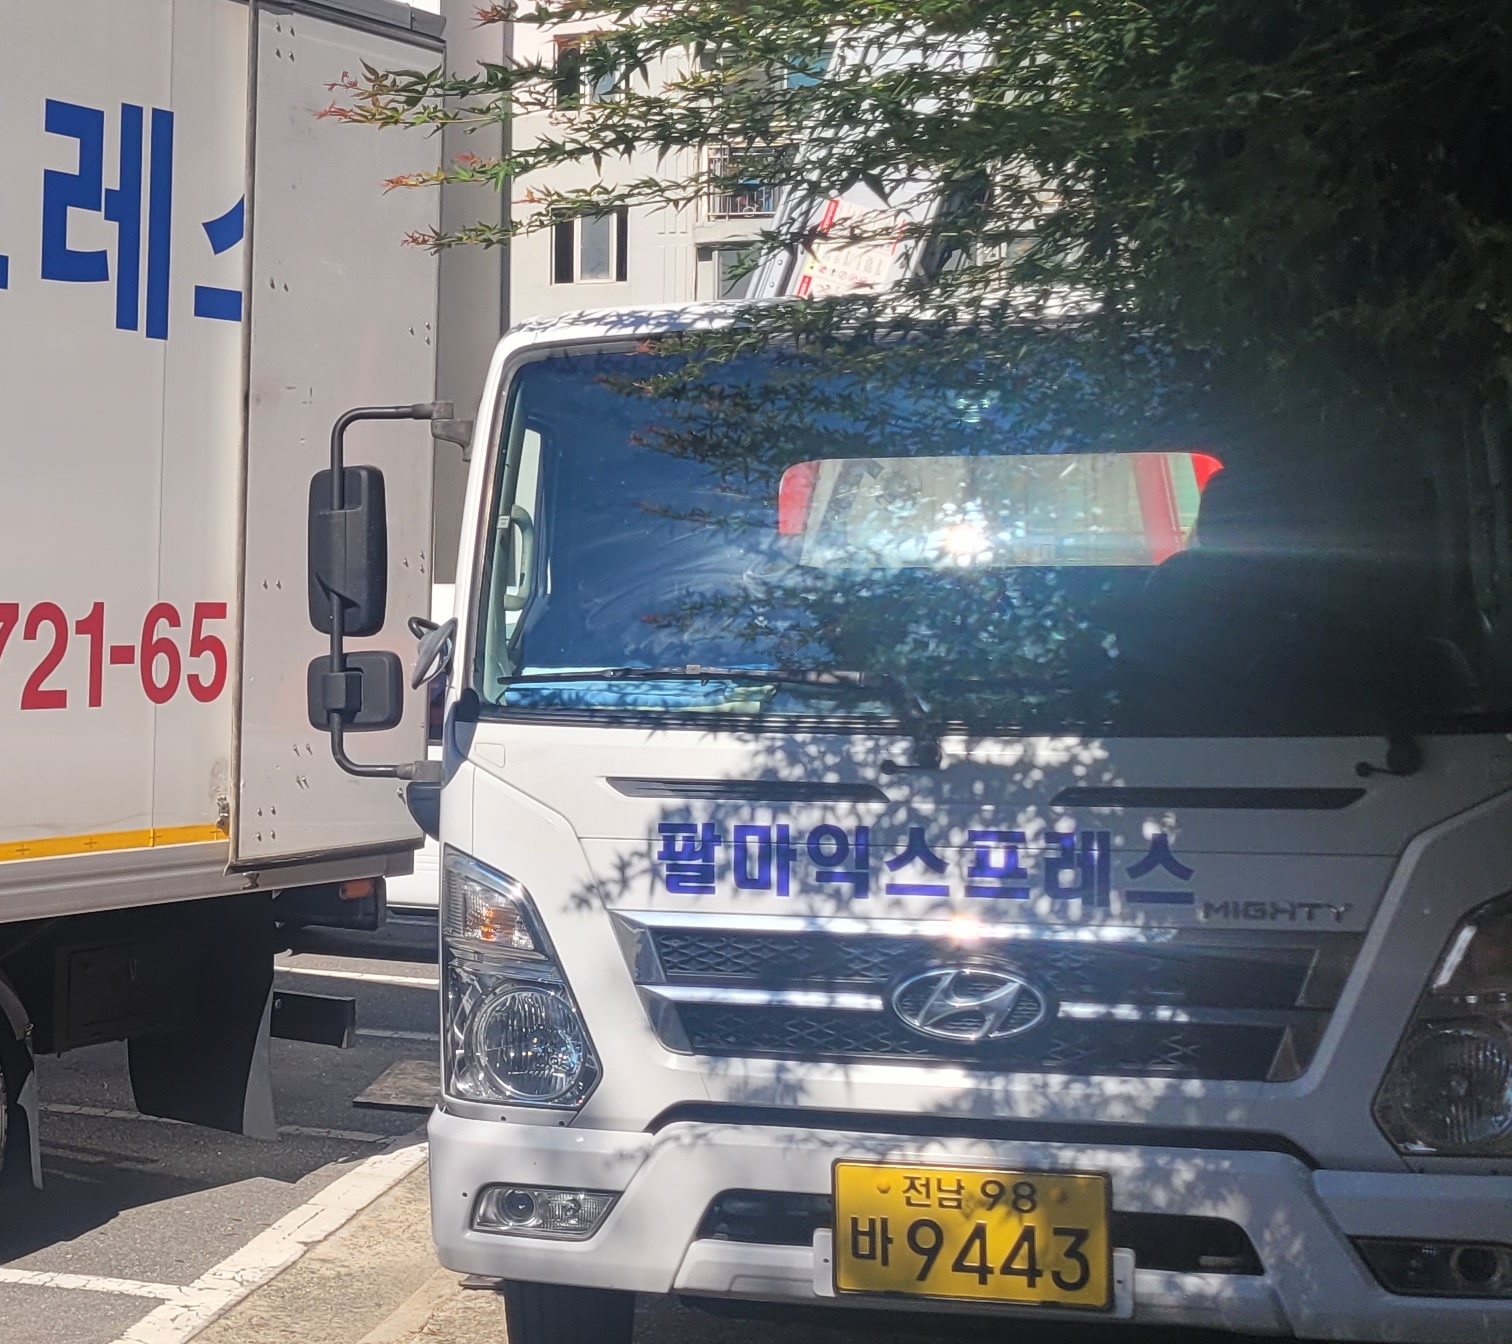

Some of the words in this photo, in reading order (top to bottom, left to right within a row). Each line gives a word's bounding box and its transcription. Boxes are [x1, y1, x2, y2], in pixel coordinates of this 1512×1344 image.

[657, 822, 1196, 909] 팔마익스프레스
[1202, 900, 1354, 923] MIGHTY
[901, 1174, 966, 1211] 전남
[980, 1179, 1037, 1214] 98
